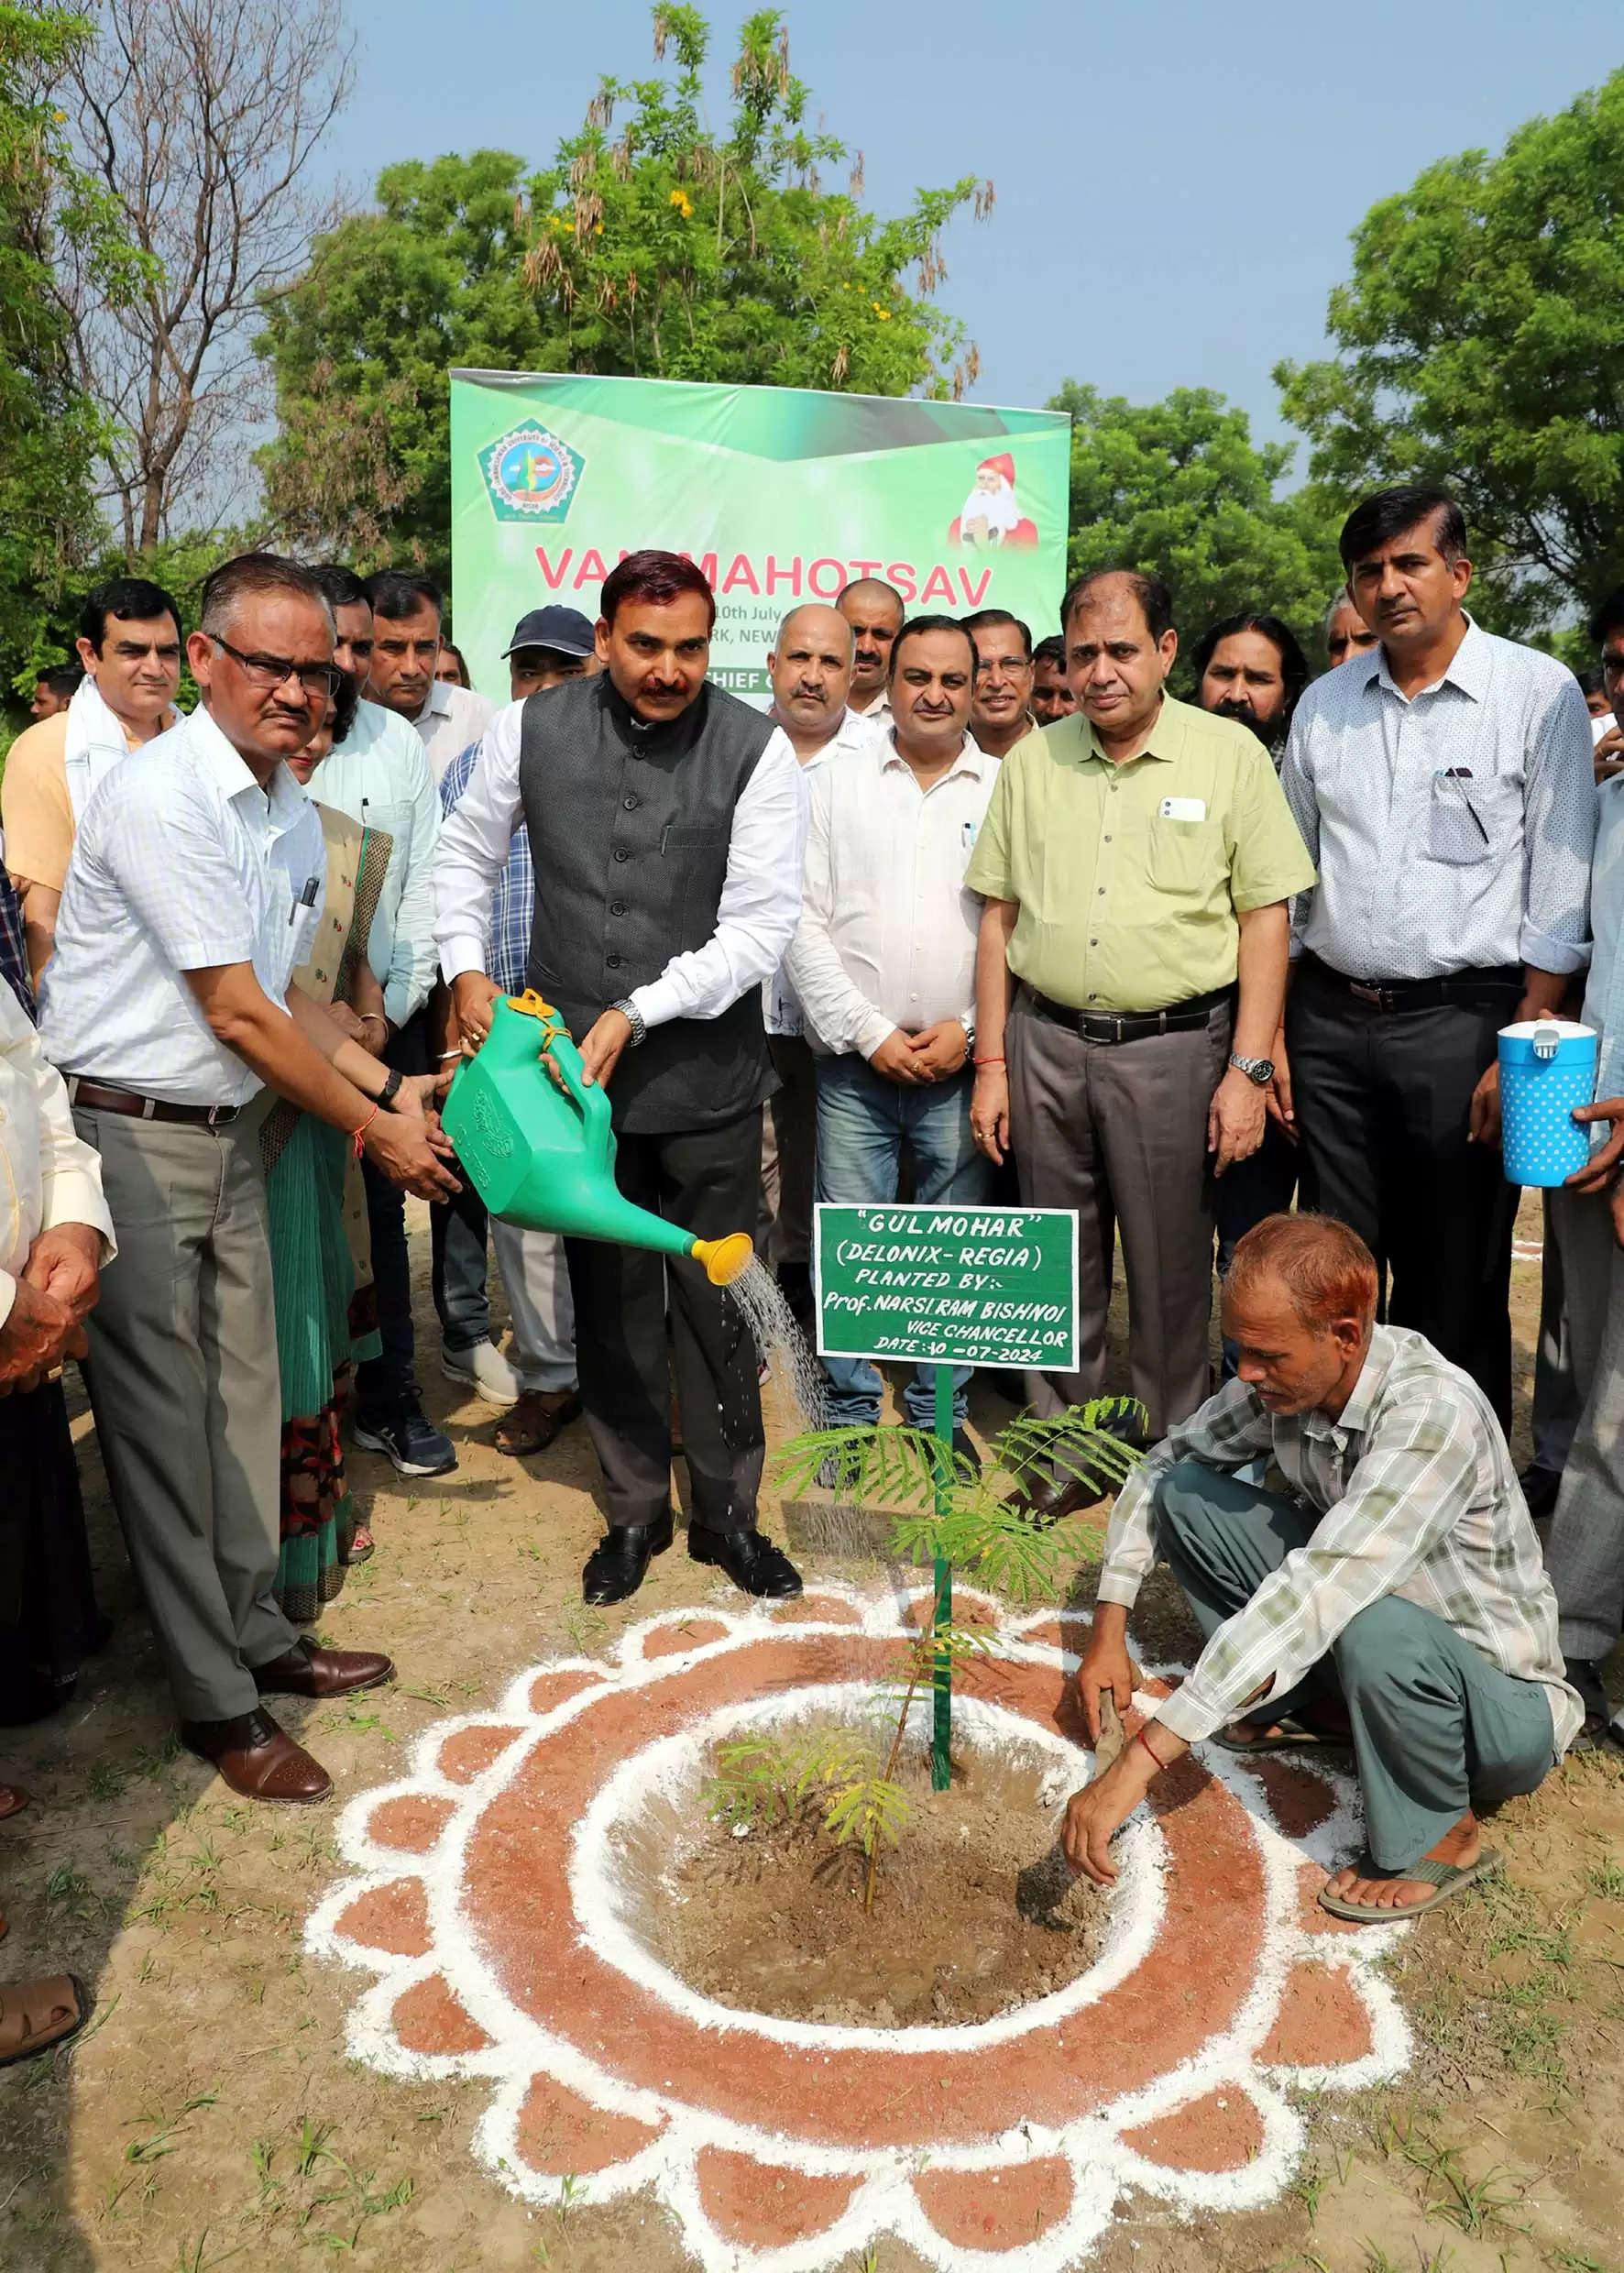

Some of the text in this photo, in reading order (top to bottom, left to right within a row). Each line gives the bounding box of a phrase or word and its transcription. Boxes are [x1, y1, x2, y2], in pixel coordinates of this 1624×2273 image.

[535, 545, 631, 589] VA
[752, 607, 782, 623] July
[706, 672, 760, 689] HIEF
[854, 1268, 950, 1288] PLANTED
[823, 1291, 872, 1316] Prof.
[980, 1301, 1067, 1323] BISHNOI
[907, 1320, 1069, 1348] VICE CHANCELLOR
